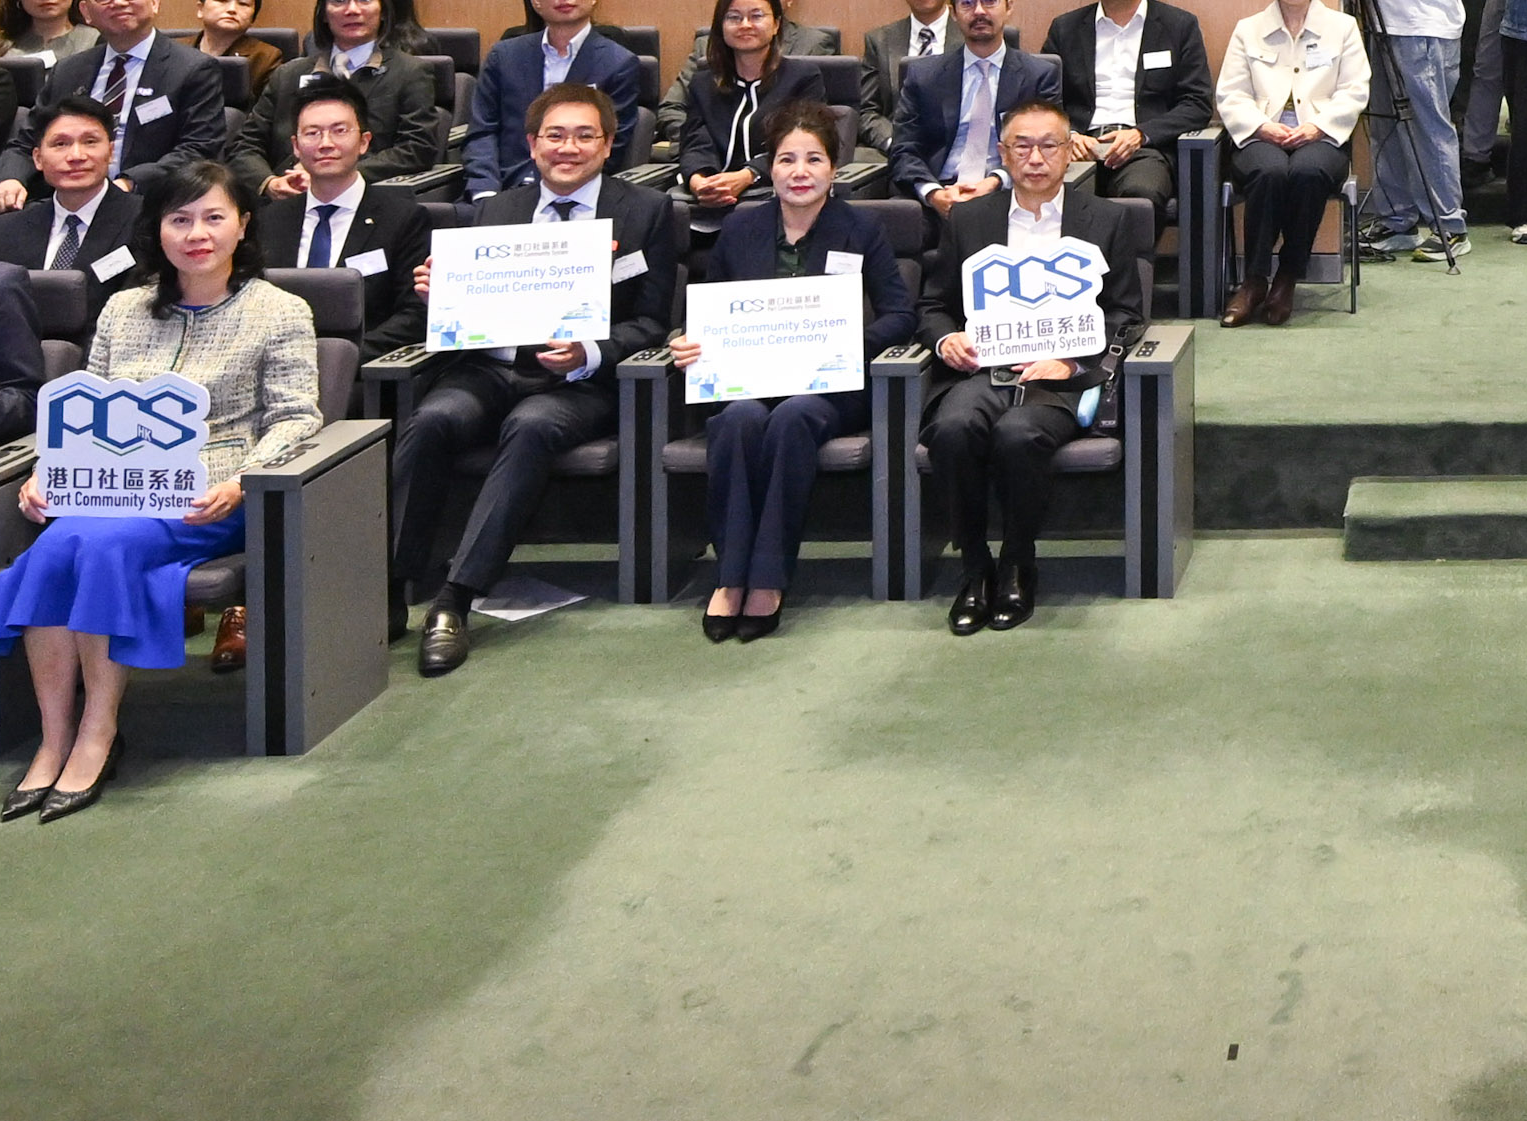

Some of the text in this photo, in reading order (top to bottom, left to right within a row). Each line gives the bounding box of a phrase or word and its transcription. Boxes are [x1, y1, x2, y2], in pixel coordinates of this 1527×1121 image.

[475, 244, 511, 260] PCS
[447, 265, 594, 282] Port Community System
[972, 252, 1093, 311] PCS
[466, 280, 575, 295] Rollout Ceremony
[730, 299, 764, 314] PCS
[703, 318, 847, 336] Port Community System
[975, 313, 1095, 344] 港口社區系統
[722, 333, 828, 348] Rollout Ceremony
[999, 339, 1056, 356] Community
[1059, 336, 1097, 350] System
[47, 389, 197, 450] PCS
[137, 424, 152, 442] HK
[46, 467, 195, 491] 港口社區系統
[46, 491, 71, 506] Port
[75, 491, 145, 511] Community
